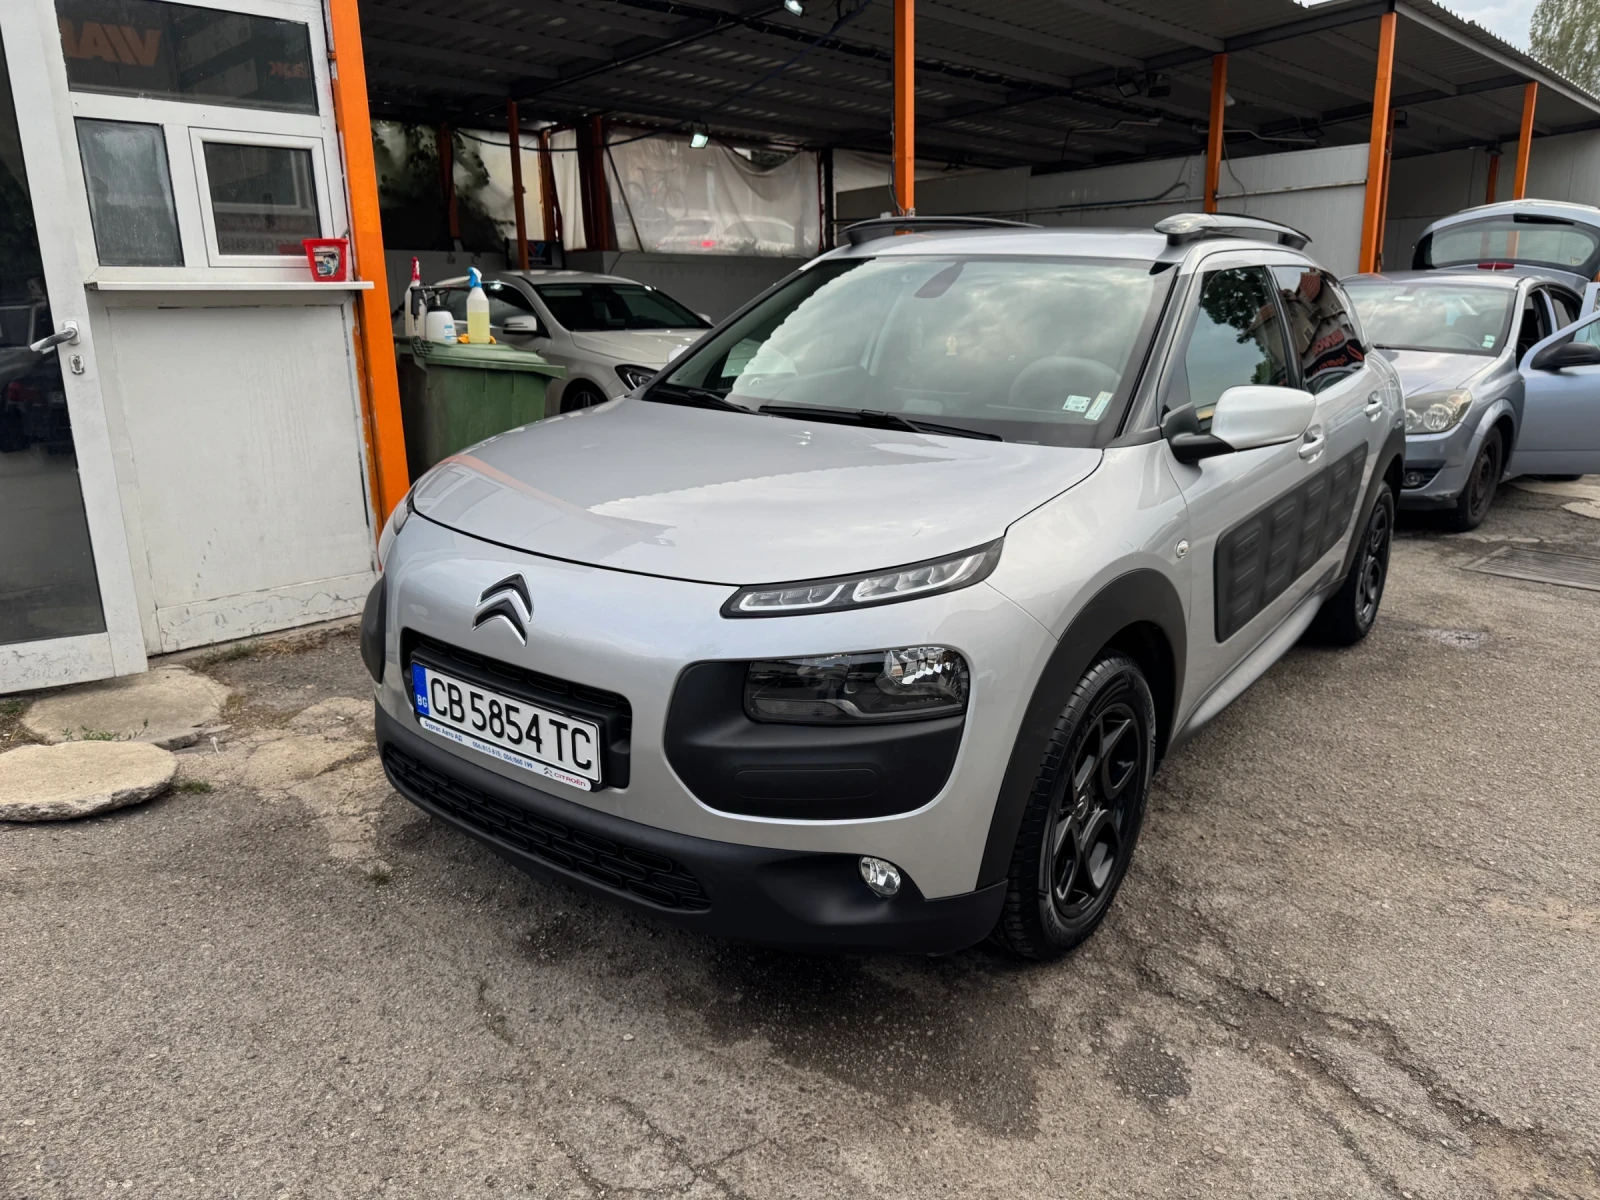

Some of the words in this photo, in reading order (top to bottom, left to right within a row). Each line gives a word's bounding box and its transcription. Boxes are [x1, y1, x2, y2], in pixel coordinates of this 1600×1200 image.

[417, 694, 428, 709] BG
[430, 677, 466, 724] CB
[469, 690, 543, 754] 5854
[548, 717, 593, 771] TC
